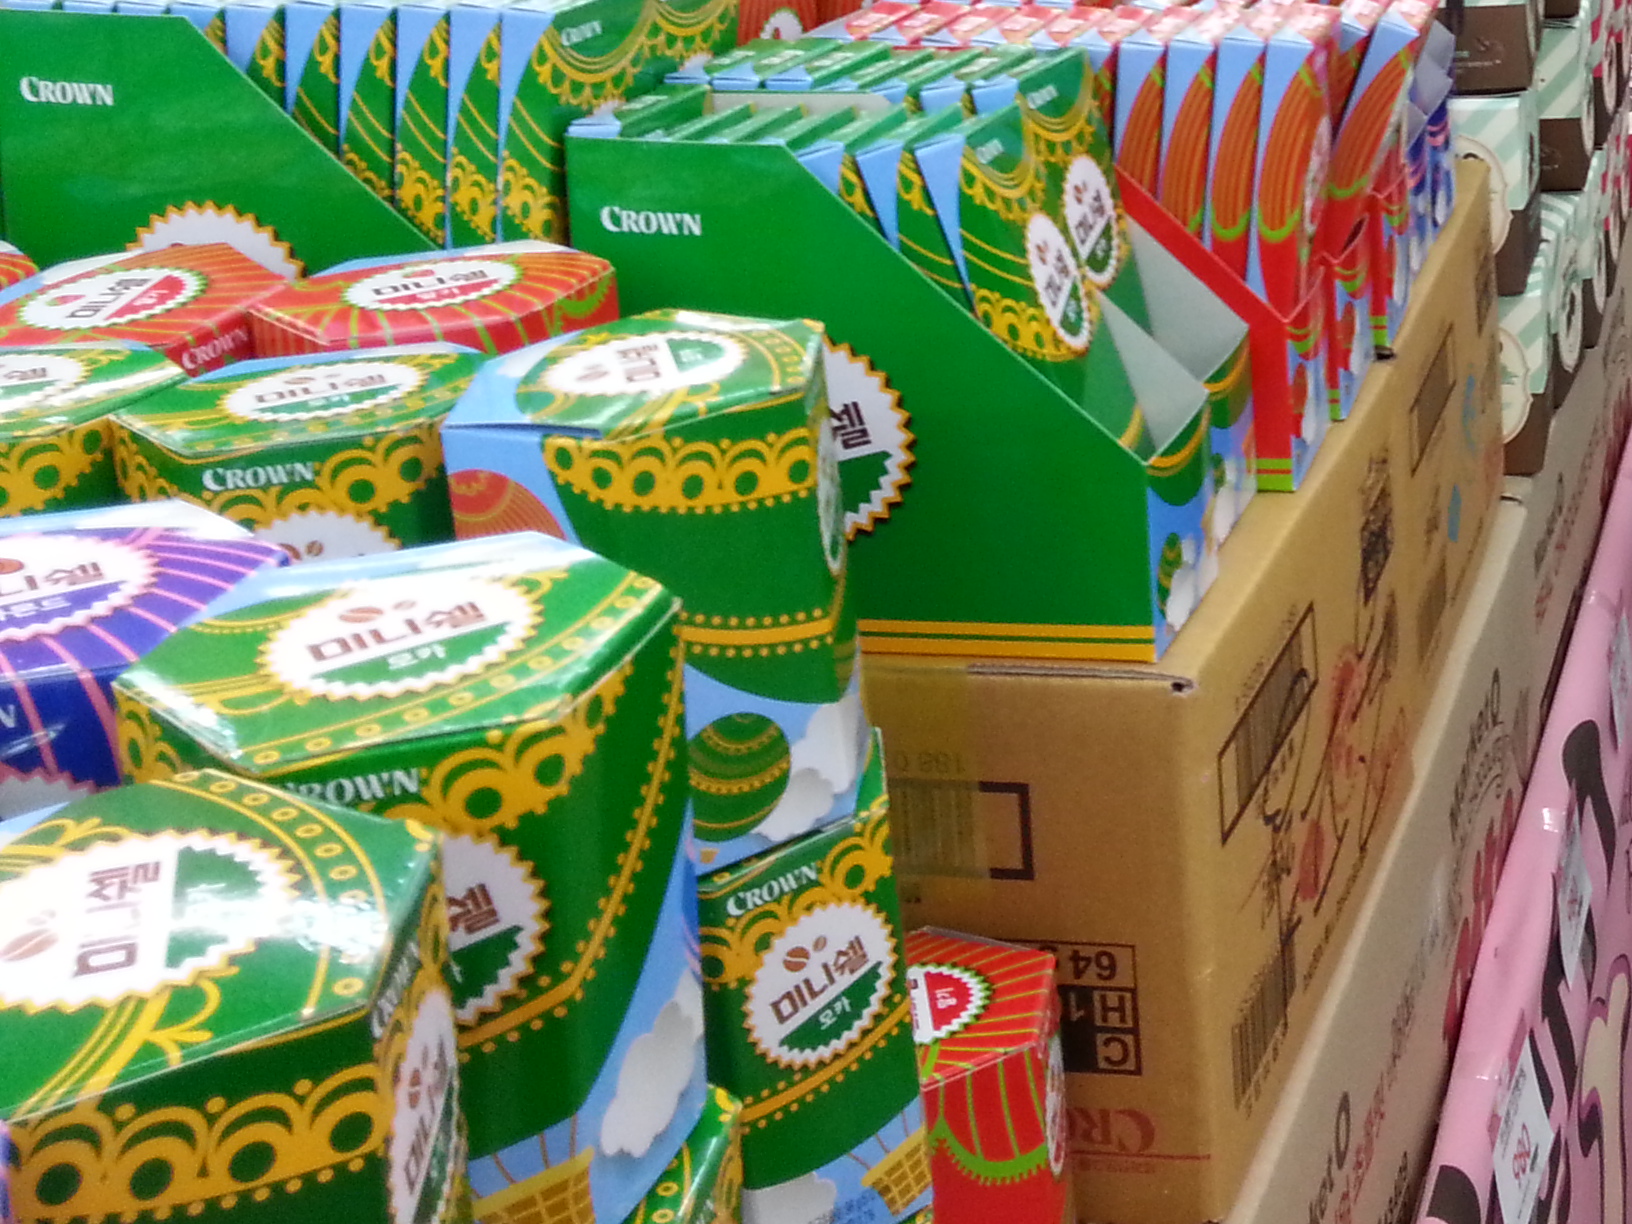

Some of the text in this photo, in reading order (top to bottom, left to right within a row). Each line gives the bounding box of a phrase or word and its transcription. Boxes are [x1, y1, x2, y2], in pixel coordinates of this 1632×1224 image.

[20, 76, 115, 107] CROWN
[600, 205, 704, 238] CROWN
[66, 277, 152, 320] 미니쉘
[372, 269, 489, 296] 미니쉘
[181, 327, 249, 370] CROWN
[255, 373, 387, 403] 미니쉘
[202, 462, 315, 492] CROWN
[306, 600, 488, 662] 미니쉘
[726, 861, 819, 917] CROWN
[769, 934, 869, 1026] 미니쉘
[1069, 949, 1117, 981] 64
[1068, 990, 1127, 1026] H 1
[1103, 1036, 1130, 1068] C
